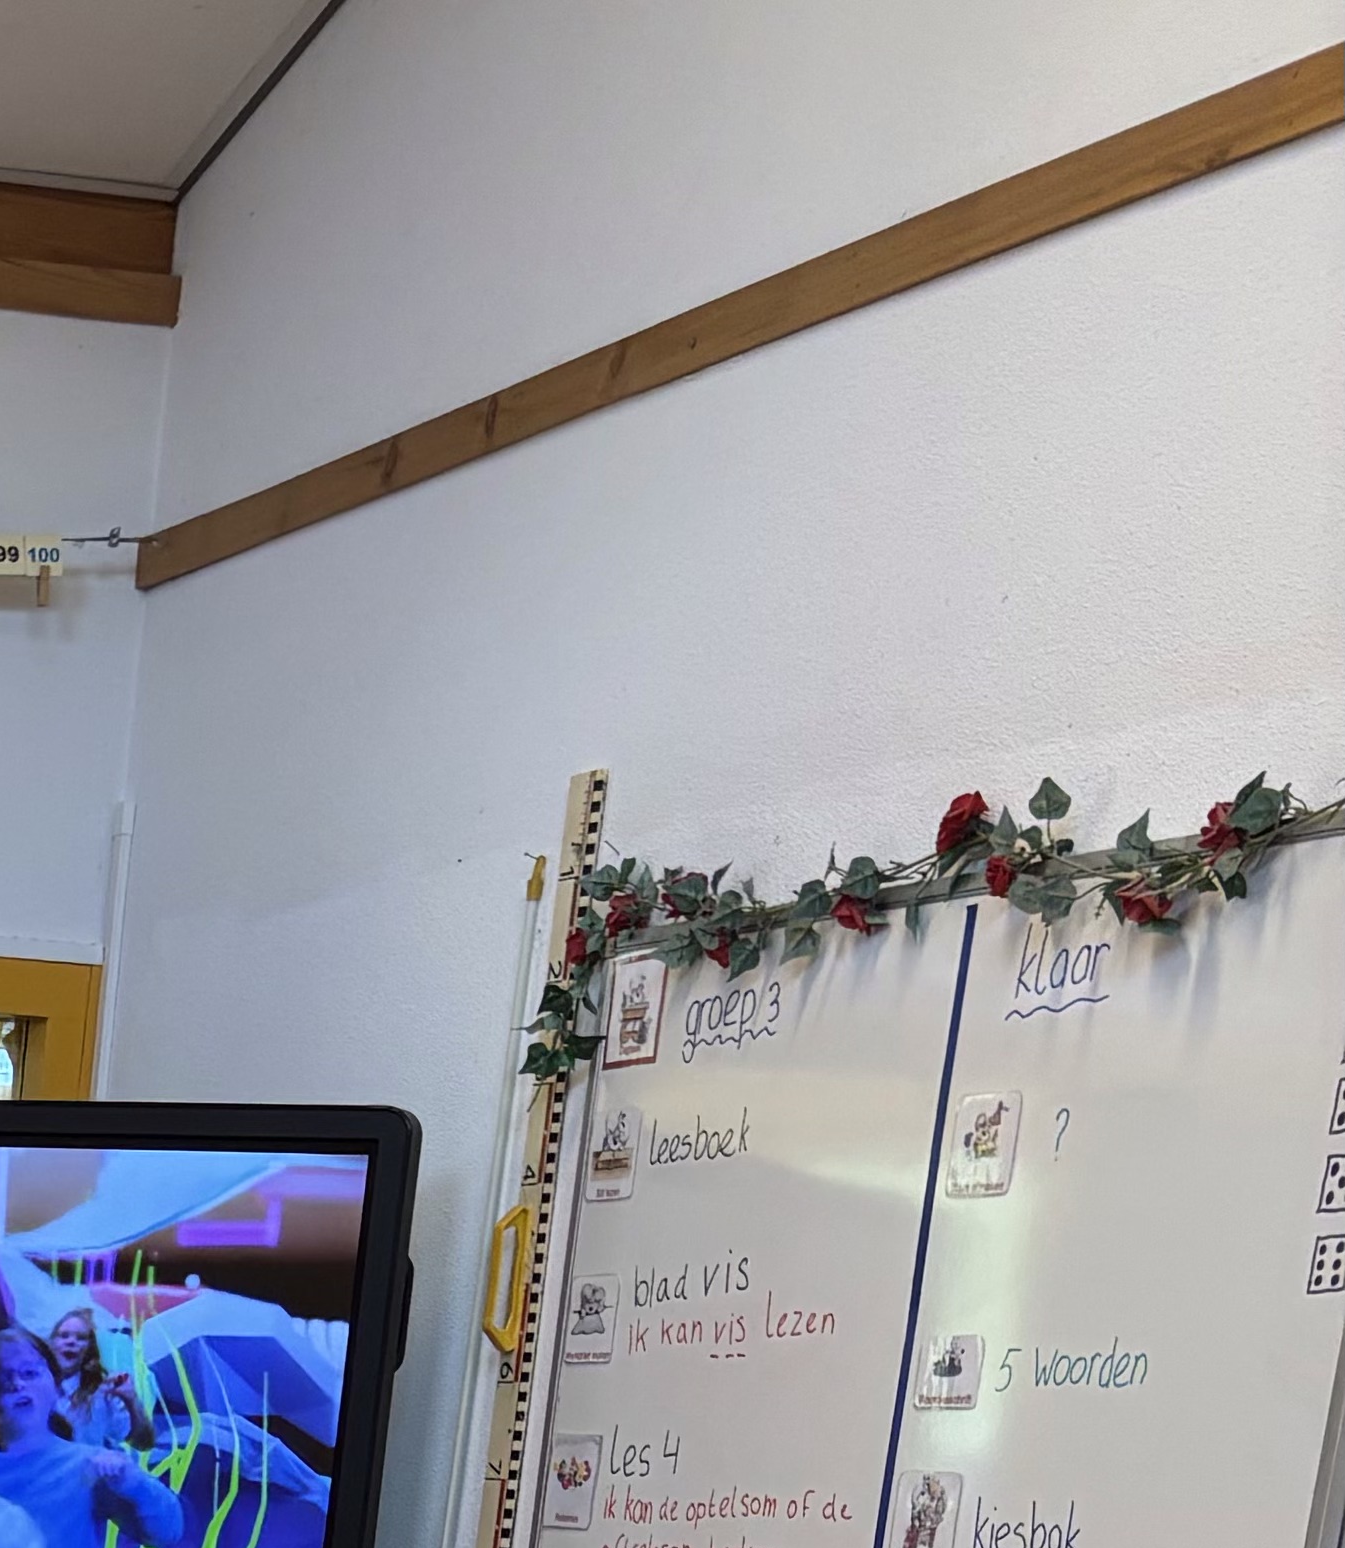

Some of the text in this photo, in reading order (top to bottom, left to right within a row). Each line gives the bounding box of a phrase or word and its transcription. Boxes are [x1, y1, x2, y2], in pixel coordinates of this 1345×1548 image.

[27, 547, 60, 563] 100
[1015, 922, 1111, 999] klaar
[682, 981, 781, 1063] groep 3
[649, 1106, 750, 1166] leesboek
[1055, 1107, 1070, 1162] ?
[634, 1249, 751, 1309] blad vis
[628, 1290, 835, 1355] ik kan vis lezen
[994, 1347, 1023, 1393] 5
[610, 1424, 681, 1478] les 4
[604, 1484, 617, 1519] ik
[623, 1484, 653, 1525] kan
[659, 1496, 679, 1523] de
[686, 1485, 777, 1530] optelsom
[822, 1493, 853, 1522] de
